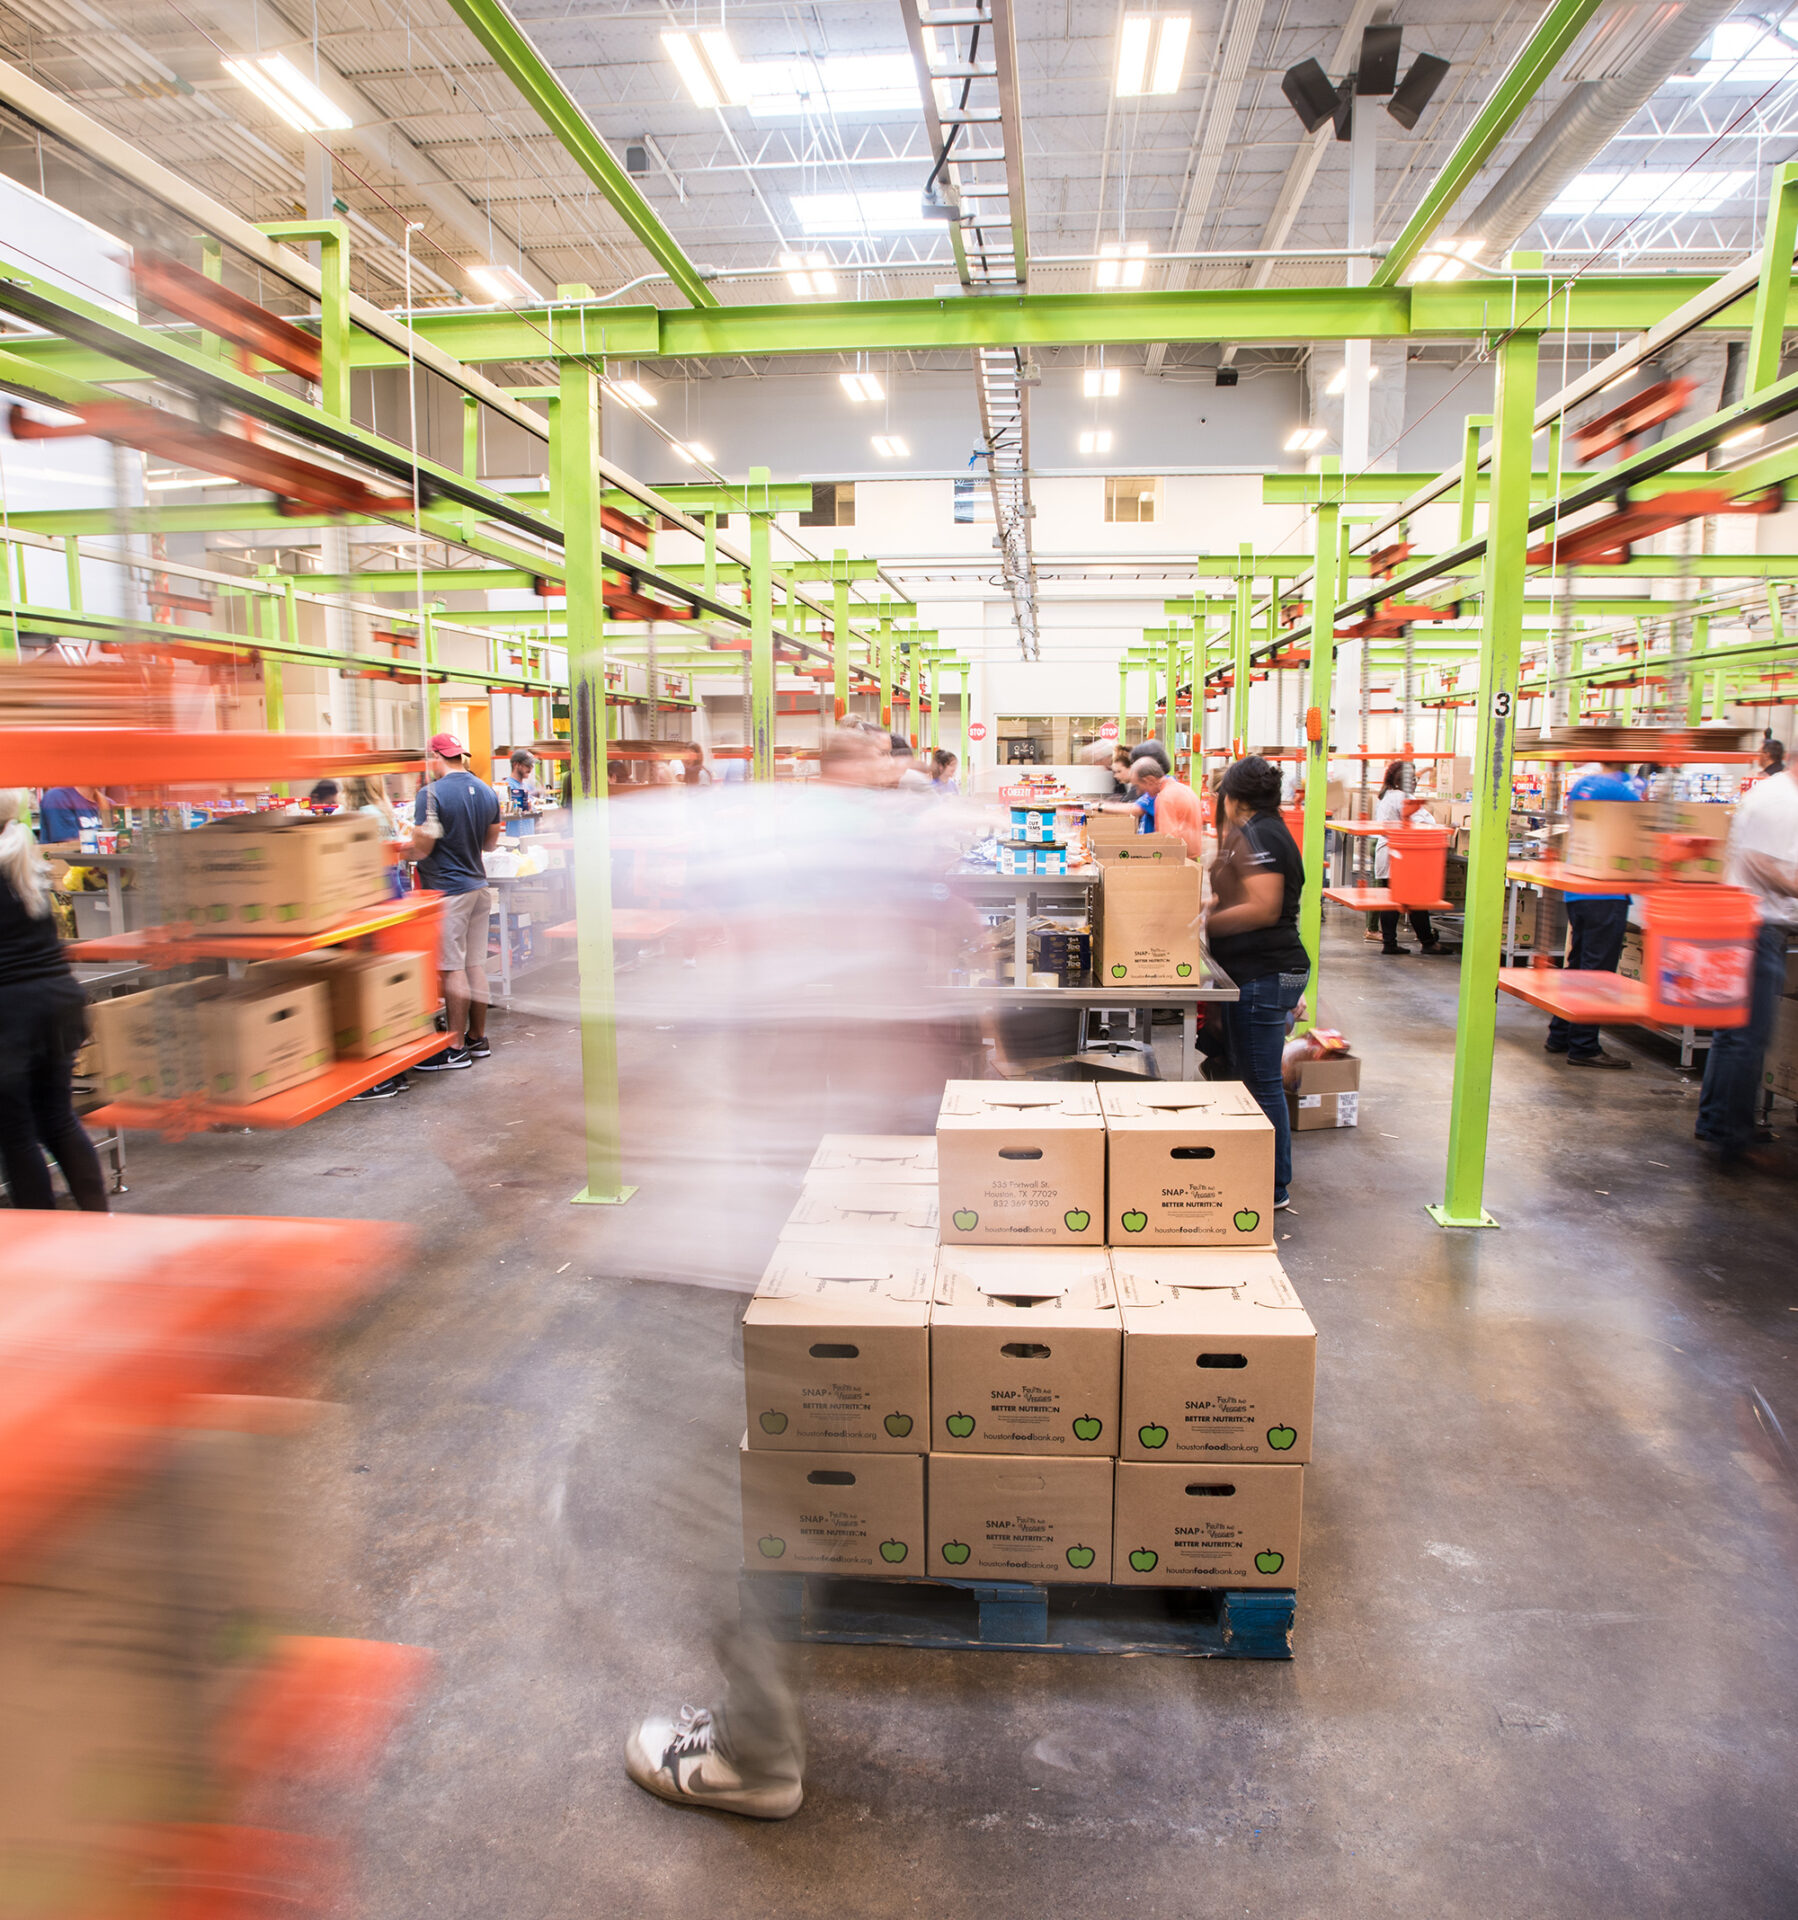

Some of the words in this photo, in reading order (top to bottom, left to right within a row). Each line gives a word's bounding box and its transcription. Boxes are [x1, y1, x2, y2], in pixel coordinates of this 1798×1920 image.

[1495, 692, 1510, 717] 3
[969, 728, 986, 737] STOP
[1102, 728, 1118, 737] STOP
[992, 1181, 1007, 1189] 535
[1019, 1190, 1028, 1198] TX
[1032, 1190, 1058, 1198] 77029
[993, 1200, 1009, 1208] 832
[1011, 1200, 1026, 1208] 369
[1029, 1200, 1049, 1208] 9390
[1155, 1227, 1227, 1235] houstonfoodbank.org
[802, 1402, 828, 1410] BETTER
[984, 1432, 1065, 1443] houstonfoodbank.org
[1176, 1443, 1259, 1453] houstonfoodbank.org
[979, 1560, 1059, 1570] houstonfoodbank.org
[1166, 1567, 1247, 1577] houstonfoodbank.org
